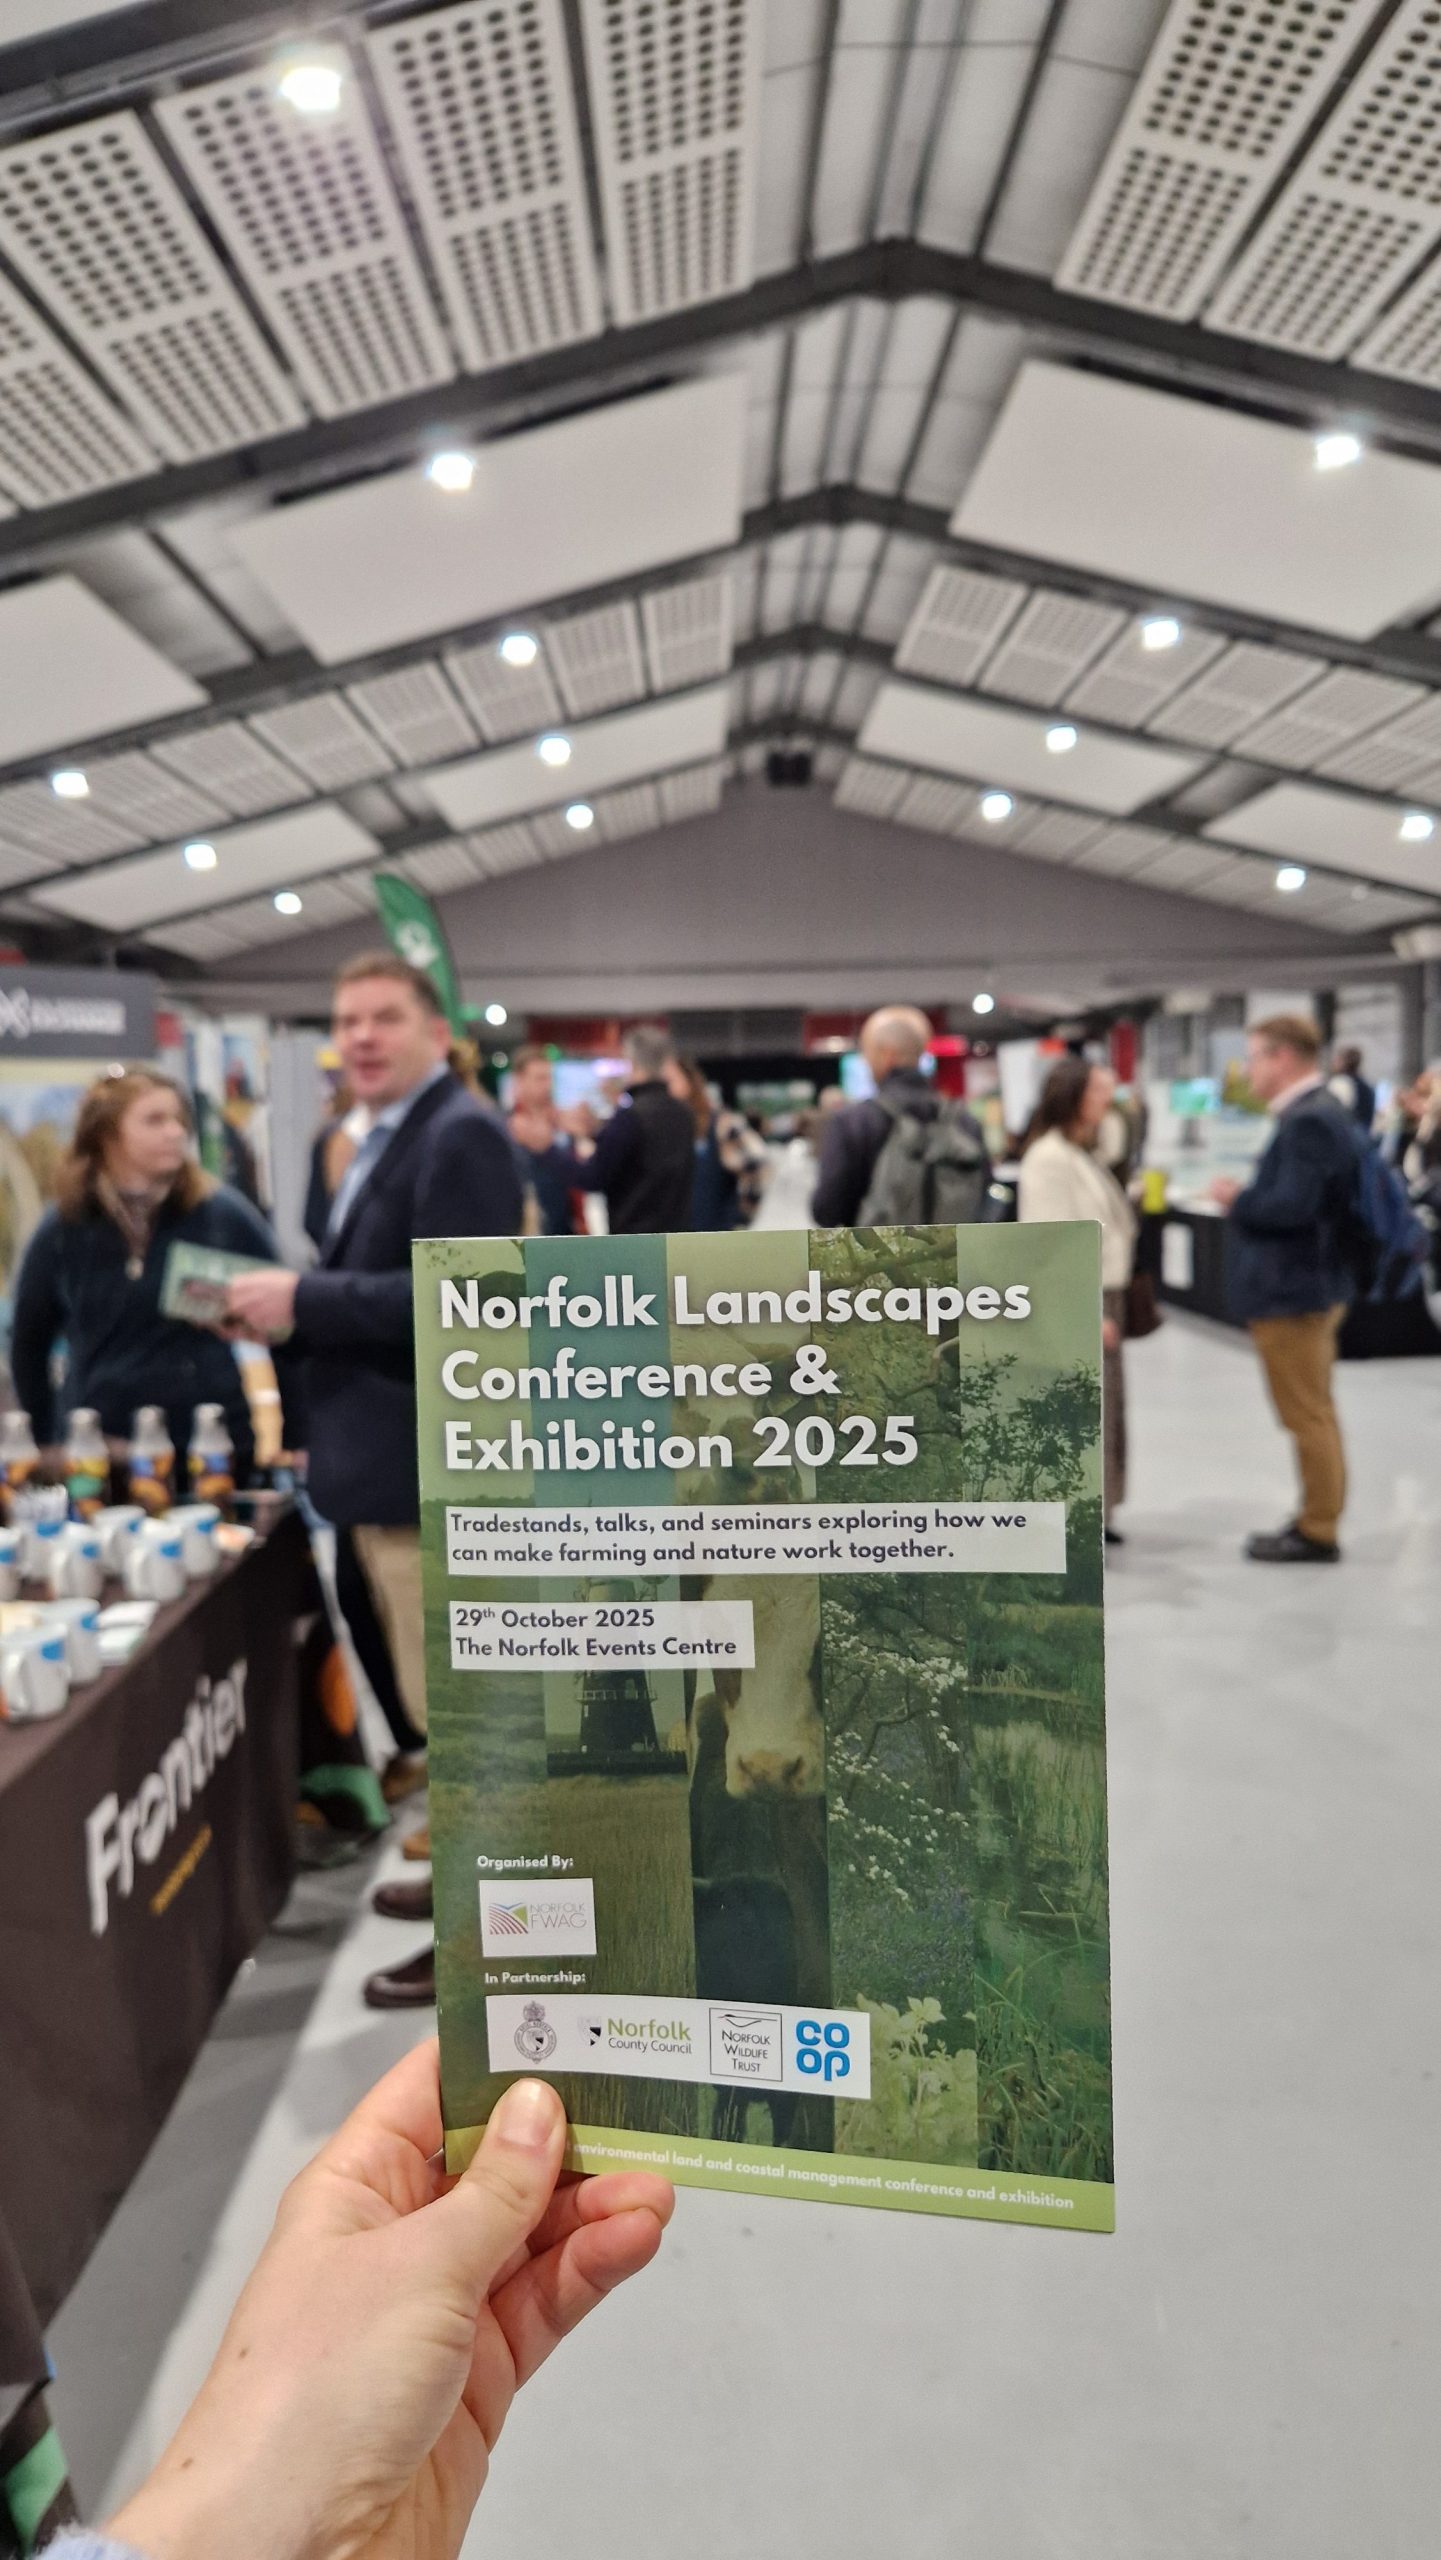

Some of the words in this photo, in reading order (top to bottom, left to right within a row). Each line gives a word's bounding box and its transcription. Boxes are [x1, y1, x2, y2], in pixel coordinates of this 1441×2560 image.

[440, 1275, 659, 1329] Norfolk
[675, 1271, 1032, 1336] Landscapes
[441, 1347, 772, 1400] Conference
[790, 1344, 840, 1396] &
[444, 1419, 733, 1471] Exhibition
[752, 1415, 919, 1467] 2025
[451, 1513, 589, 1535] Tradestands,
[595, 1513, 655, 1535] talks,
[662, 1512, 704, 1531] and
[711, 1511, 812, 1531] seminars
[818, 1510, 927, 1534] exploring
[934, 1508, 984, 1528] how
[991, 1513, 1027, 1528] we
[452, 1547, 488, 1562] can
[494, 1543, 553, 1562] make
[559, 1543, 646, 1566] farming
[653, 1542, 695, 1561] and
[702, 1544, 776, 1560] nature
[782, 1539, 842, 1559] work
[848, 1538, 955, 1564] together.
[501, 1608, 588, 1628] October
[595, 1608, 655, 1628] 2025
[456, 1637, 493, 1656] The
[498, 1636, 580, 1657] Norfolk
[587, 1637, 656, 1656] Events
[662, 1636, 737, 1655] Centre
[85, 1658, 247, 1937] Frontier
[477, 1855, 548, 1870] Organised
[552, 1855, 574, 1869] By:
[530, 1903, 585, 1914] NORFOLK
[530, 1914, 588, 1929] FWAG
[485, 1973, 498, 1984] In
[502, 1971, 587, 1985] Partnership:
[608, 2018, 692, 2041] Norfolk
[608, 2037, 648, 2053] County
[651, 2040, 692, 2054] Council
[574, 2143, 669, 2163] environmental
[672, 2151, 702, 2169] land
[706, 2158, 732, 2172] and
[735, 2162, 784, 2178] coastal
[788, 2169, 881, 2188] management
[885, 2178, 963, 2198] conference
[967, 2187, 995, 2200] and
[999, 2190, 1074, 2209] exhibition
